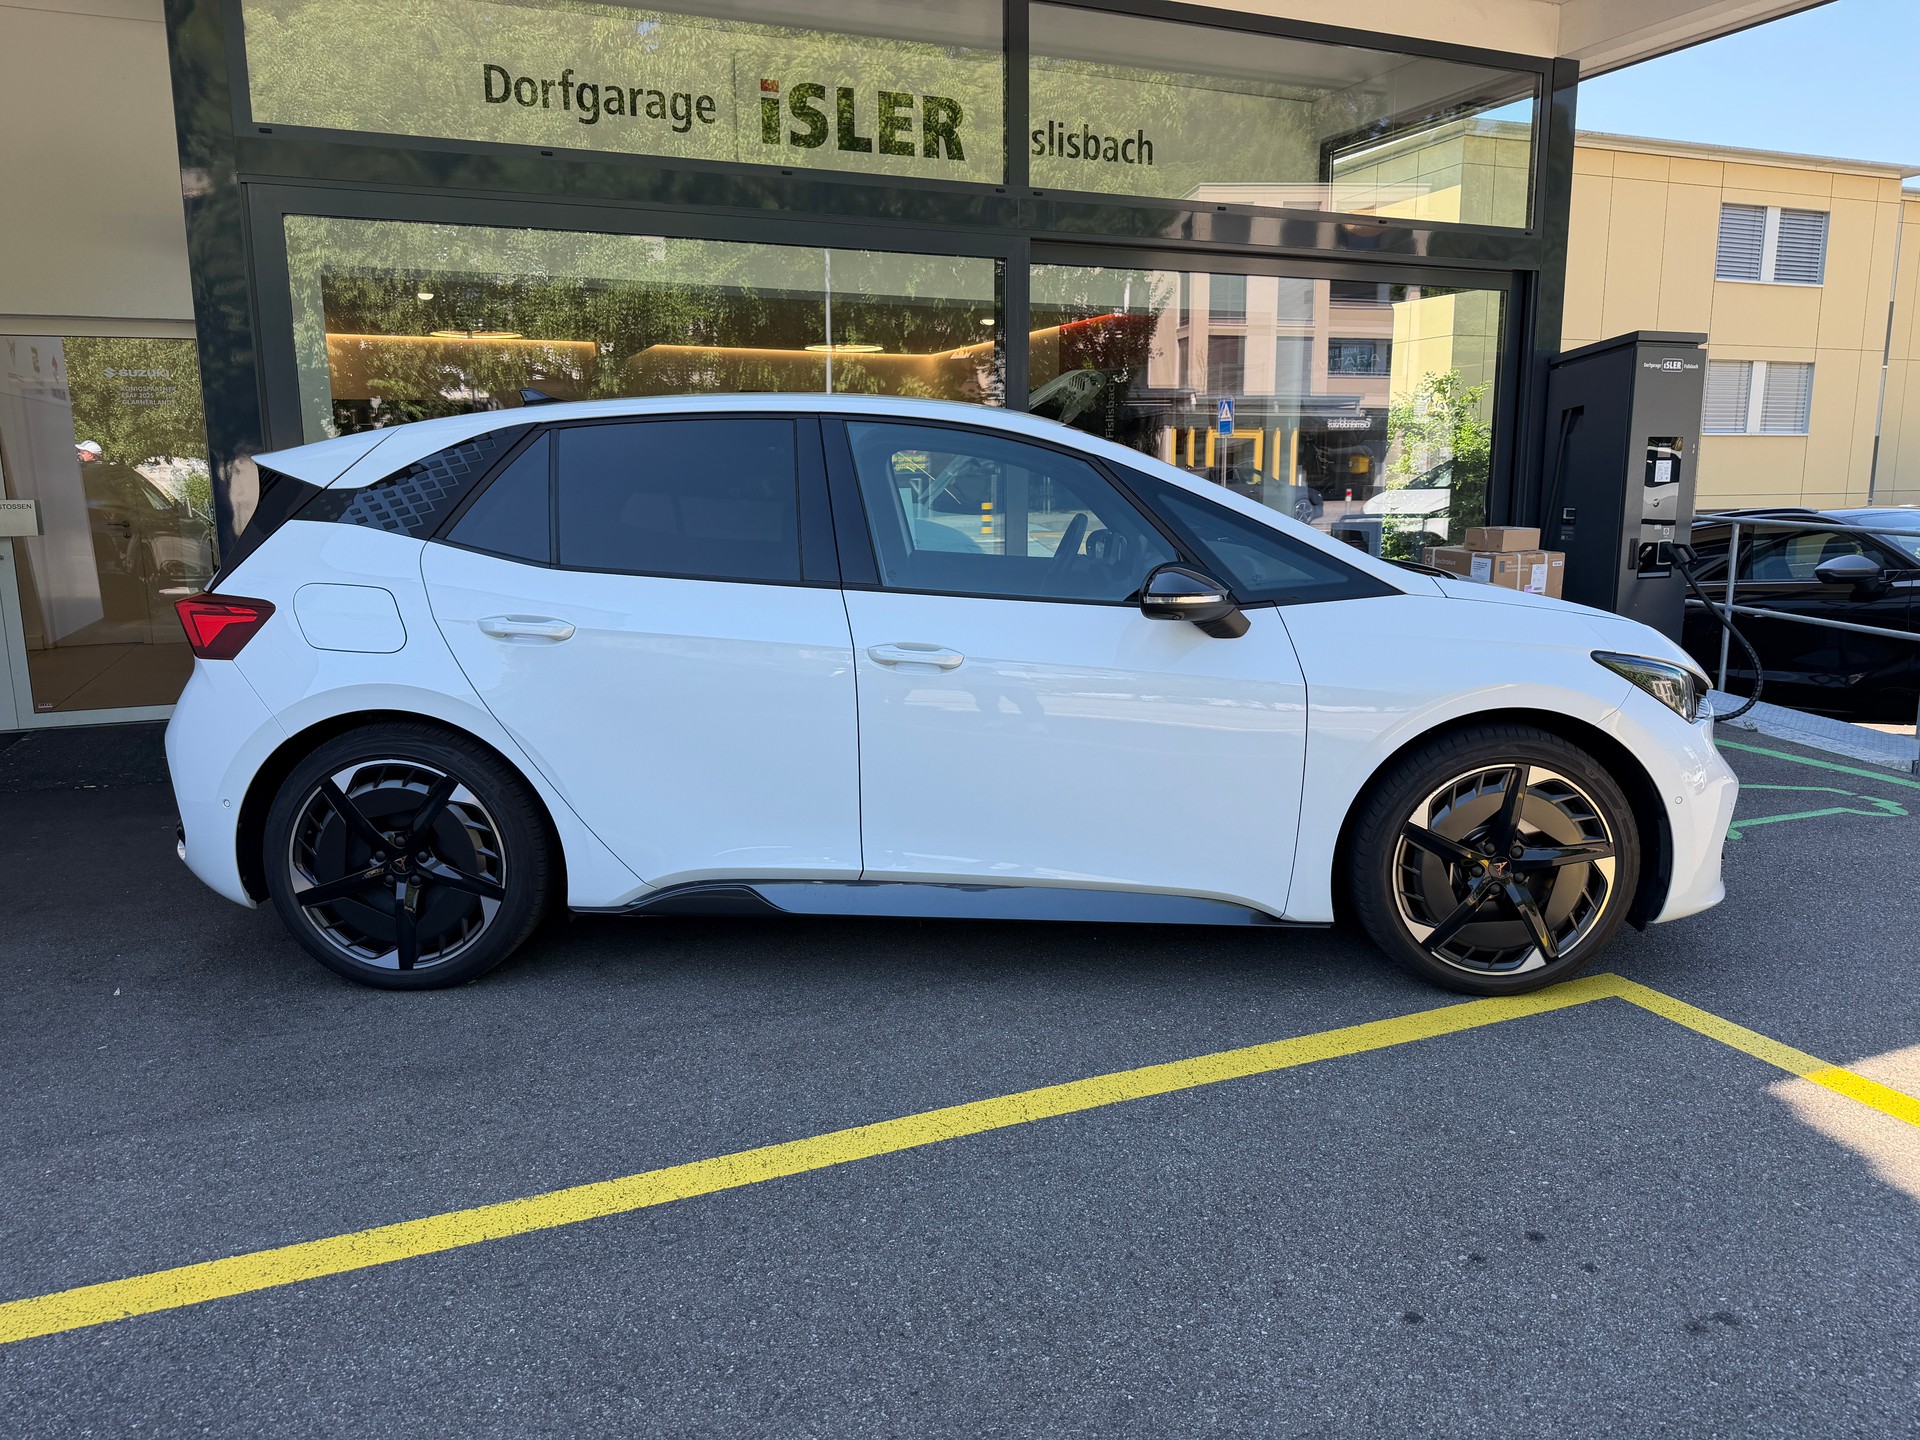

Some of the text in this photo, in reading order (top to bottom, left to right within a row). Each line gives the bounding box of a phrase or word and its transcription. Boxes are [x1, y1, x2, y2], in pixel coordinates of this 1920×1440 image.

[483, 63, 717, 134] Dorfgarage
[1031, 120, 1154, 166] slisbach
[118, 369, 170, 377] SUZUKI
[1105, 379, 1115, 438] Fislisbach
